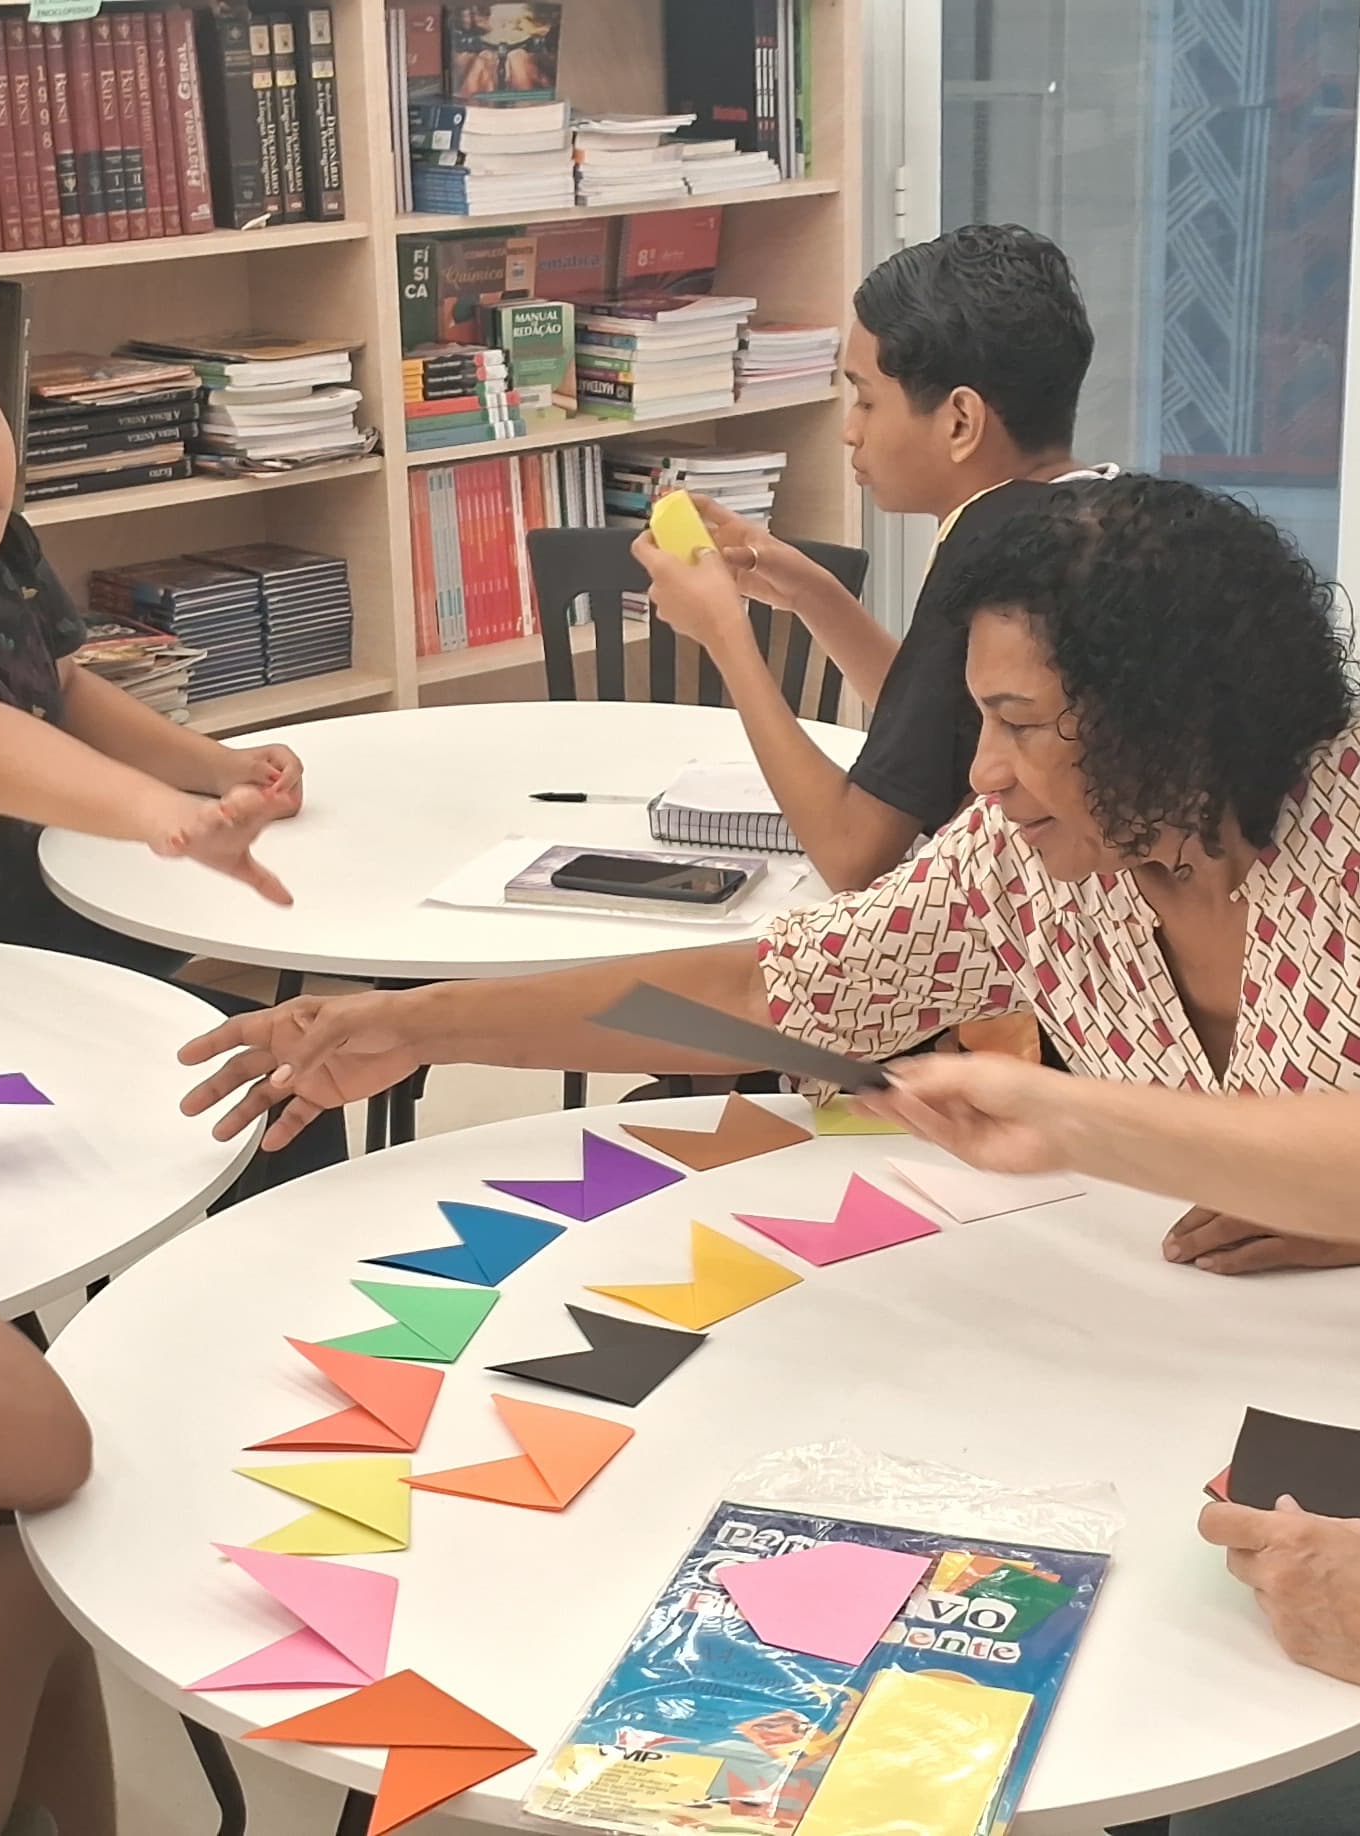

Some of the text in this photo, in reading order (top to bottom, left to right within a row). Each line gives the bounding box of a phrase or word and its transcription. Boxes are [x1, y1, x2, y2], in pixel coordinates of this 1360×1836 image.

[178, 42, 192, 100] GERAL
[404, 284, 428, 298] CA
[514, 310, 558, 323] MANUAL
